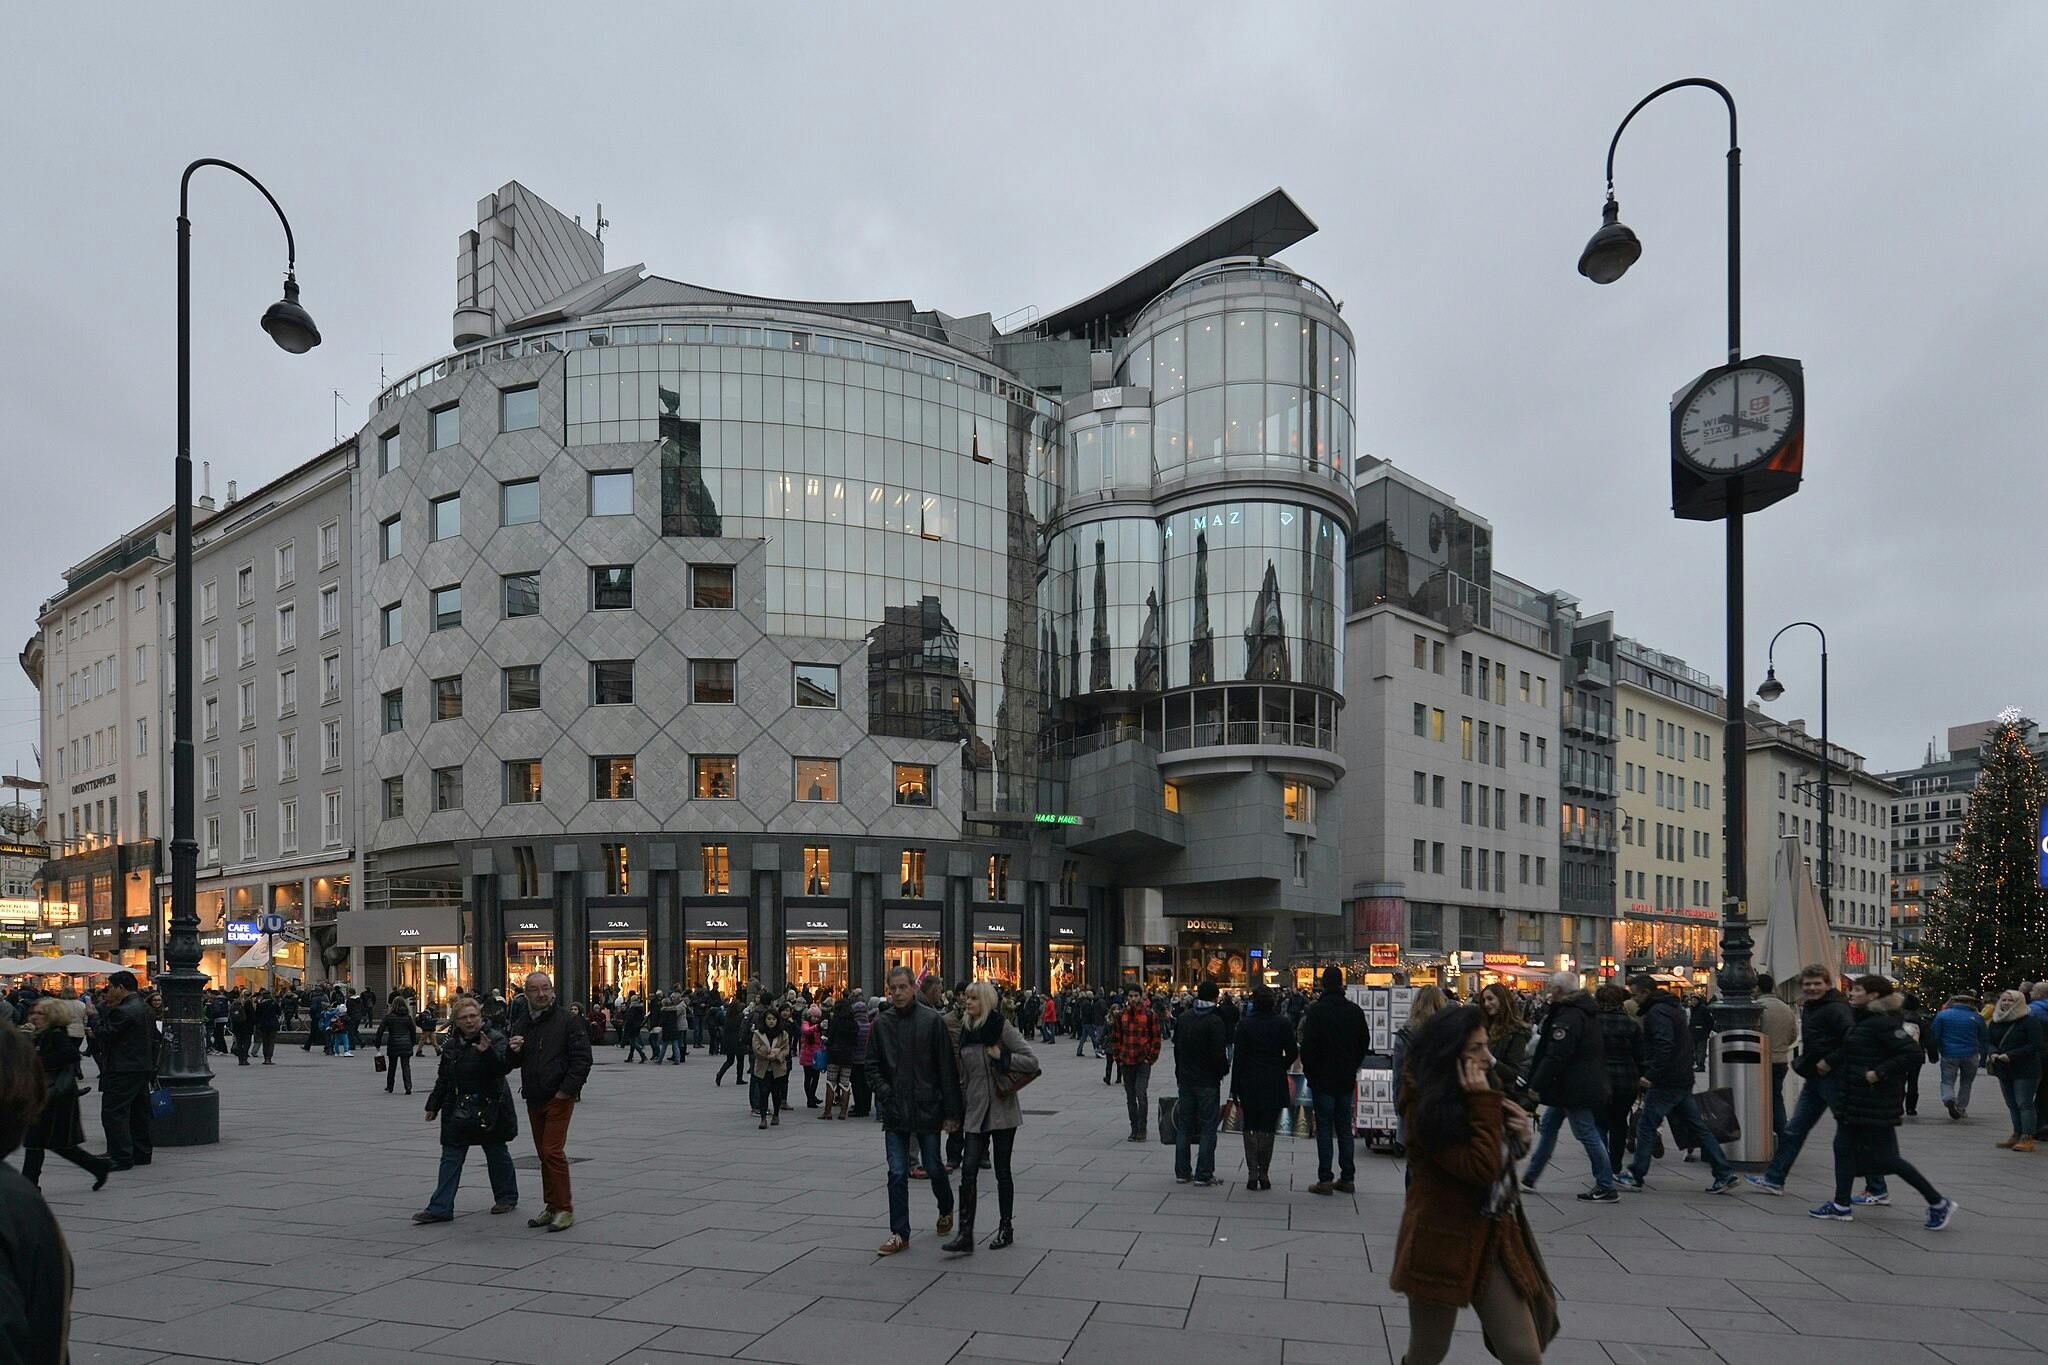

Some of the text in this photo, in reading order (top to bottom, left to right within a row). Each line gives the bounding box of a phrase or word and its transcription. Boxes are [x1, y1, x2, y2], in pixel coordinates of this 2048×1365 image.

[1034, 814, 1078, 825] HAAS HAUS
[267, 917, 281, 931] U
[705, 920, 728, 928] ZARA
[1186, 920, 1200, 929] DO
[1200, 921, 1206, 929] &
[1207, 921, 1217, 929] CO
[227, 933, 263, 942] EUROP
